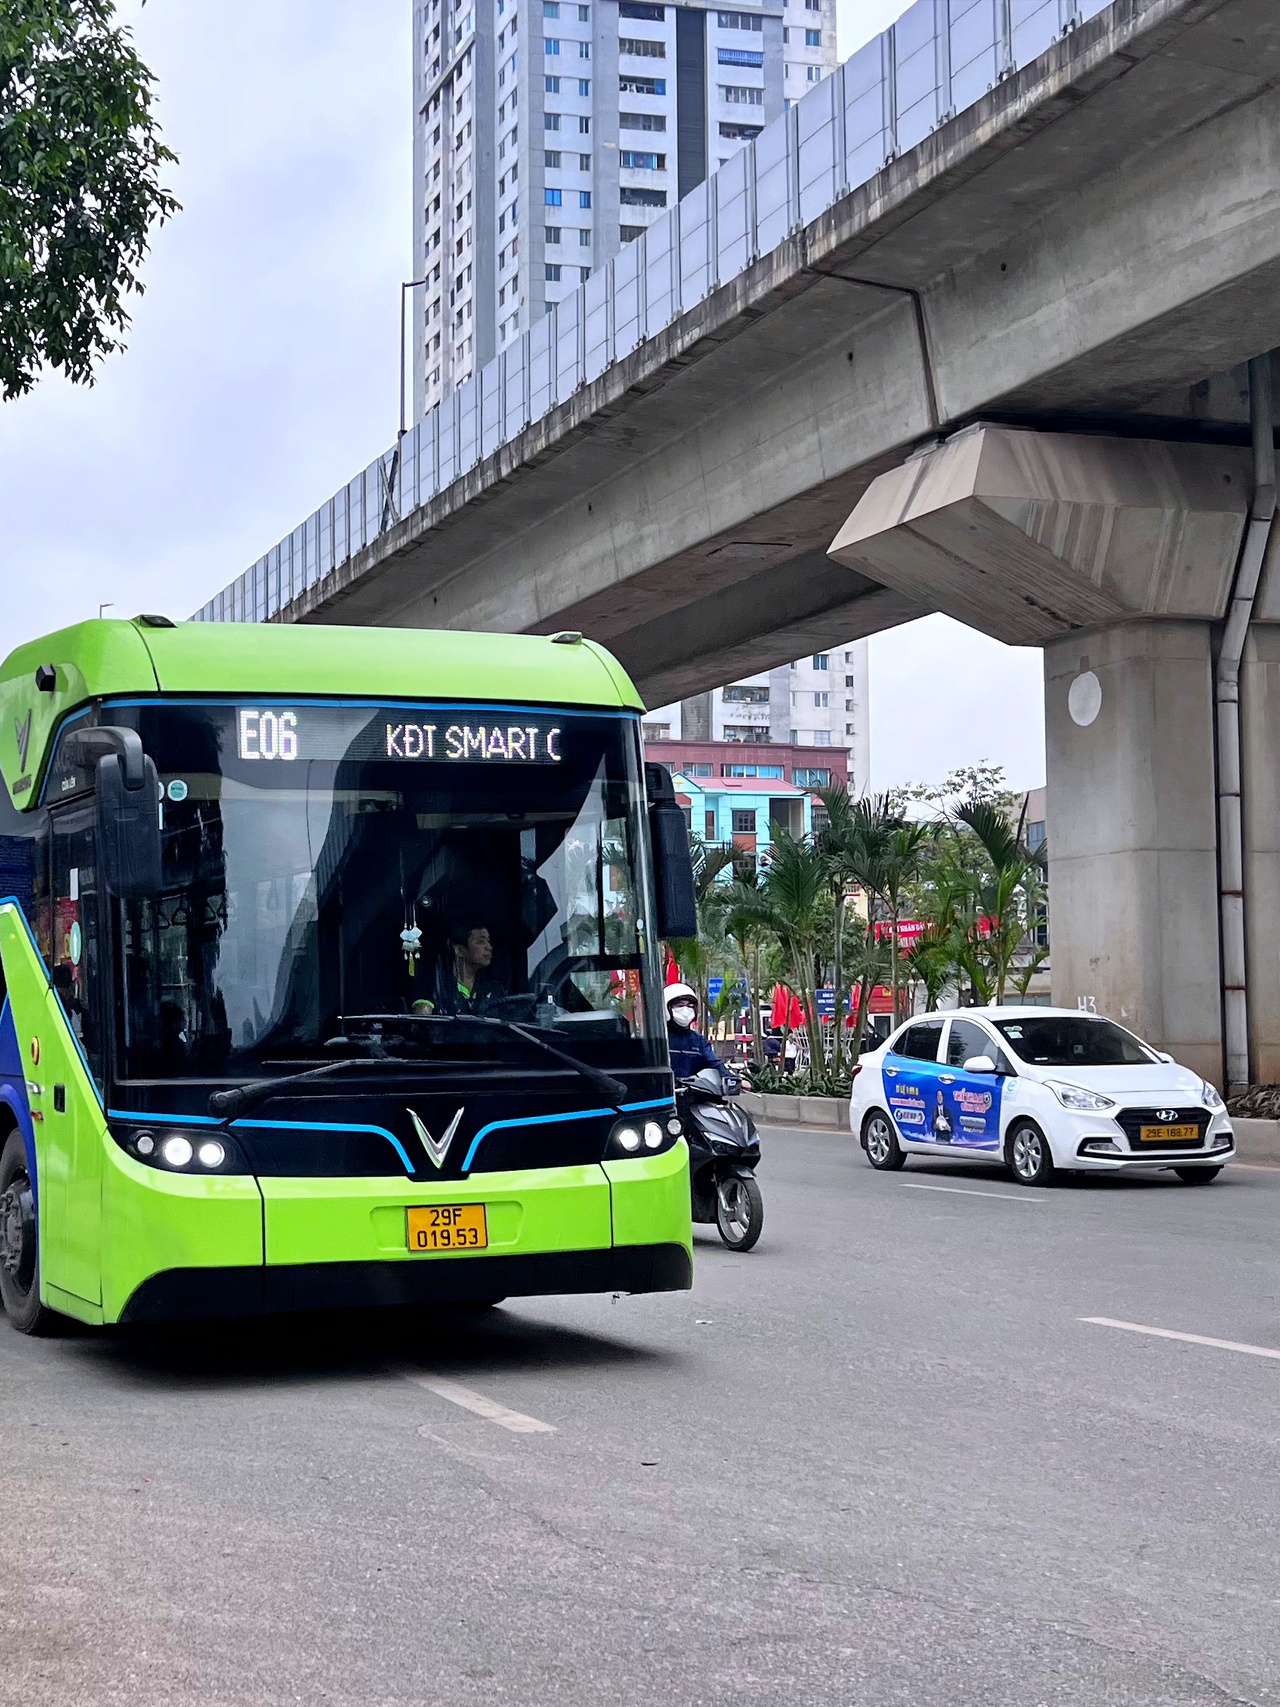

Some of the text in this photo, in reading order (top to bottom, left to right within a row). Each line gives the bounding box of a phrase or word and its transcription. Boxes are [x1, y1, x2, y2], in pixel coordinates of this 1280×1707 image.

[239, 709, 298, 760] E06
[386, 723, 437, 758] KĐT
[445, 725, 539, 760] SMART
[429, 1207, 463, 1227] 29F
[417, 1227, 479, 1248] 019.53
